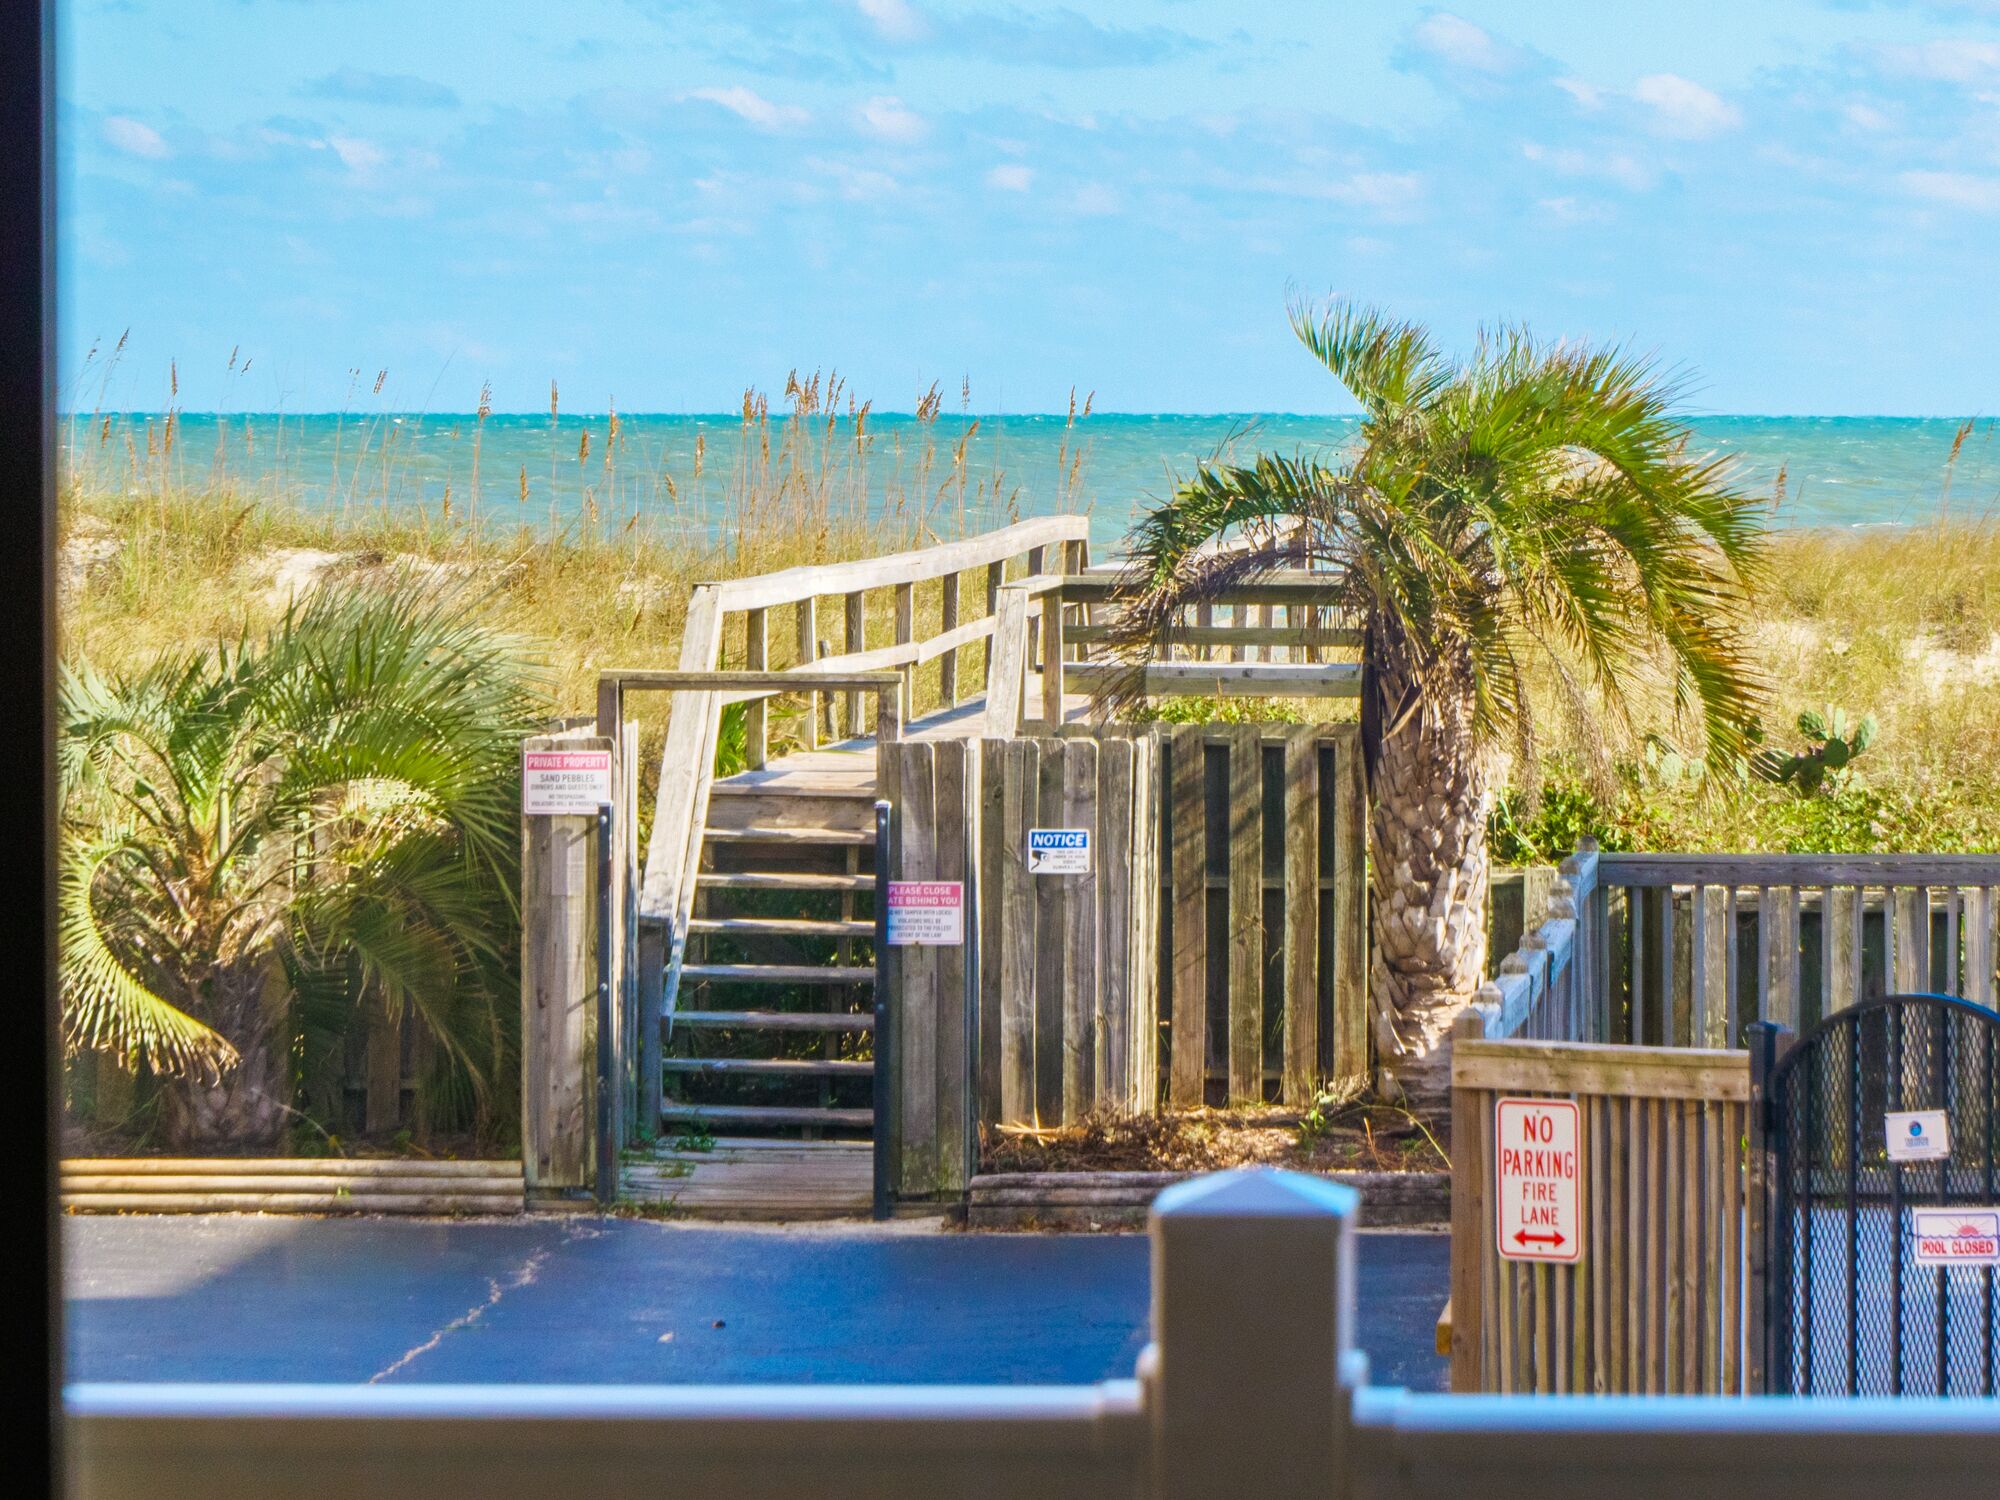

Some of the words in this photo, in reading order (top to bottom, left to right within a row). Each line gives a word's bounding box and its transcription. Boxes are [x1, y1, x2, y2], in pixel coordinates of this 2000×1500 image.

[528, 756, 561, 768] PRIVATE
[563, 756, 607, 768] PROPERTY
[540, 773, 560, 783] SAND
[562, 773, 595, 783] PEBBLES
[555, 783, 566, 791] AND
[1033, 833, 1085, 847] NOTICE
[888, 886, 921, 895] PLEASE
[923, 886, 951, 895] CLOSE
[888, 896, 903, 905] ATE
[905, 896, 939, 905] BEHIND
[940, 896, 958, 905] YOU
[1523, 1114, 1553, 1144] NO
[1503, 1148, 1573, 1179] PARKING
[1522, 1181, 1557, 1202] FIRE
[1521, 1205, 1559, 1226] LANE
[1922, 1240, 1947, 1255] POOL
[1951, 1240, 1994, 1255] CLOSED
